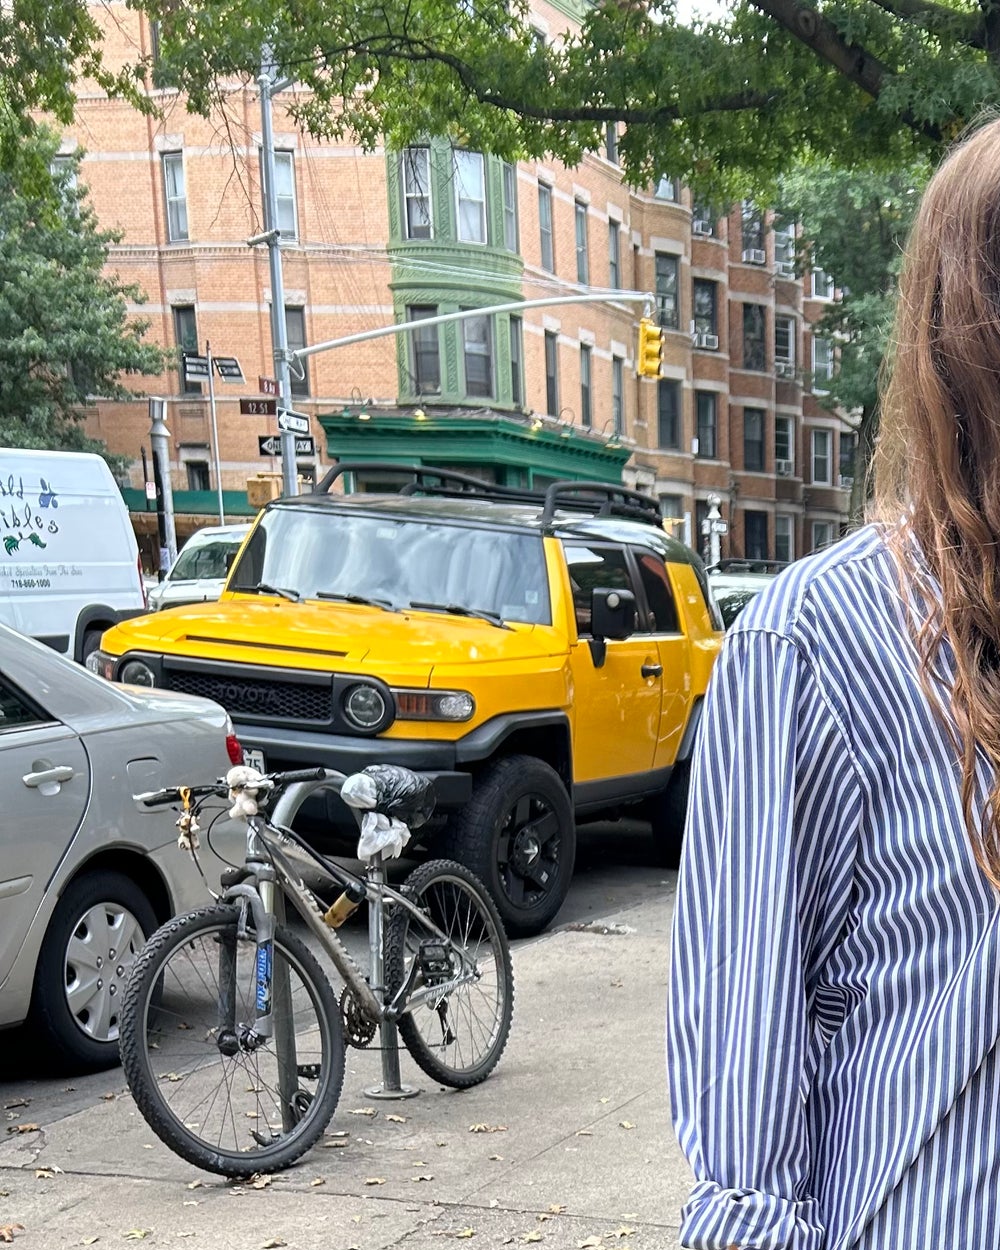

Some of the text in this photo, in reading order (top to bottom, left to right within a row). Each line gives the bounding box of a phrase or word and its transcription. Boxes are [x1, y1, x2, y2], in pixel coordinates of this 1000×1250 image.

[248, 403, 256, 413] 12
[297, 441, 308, 450] AY
[0, 474, 24, 500] ild
[0, 502, 59, 534] ibles
[216, 684, 279, 701] TOYOTA
